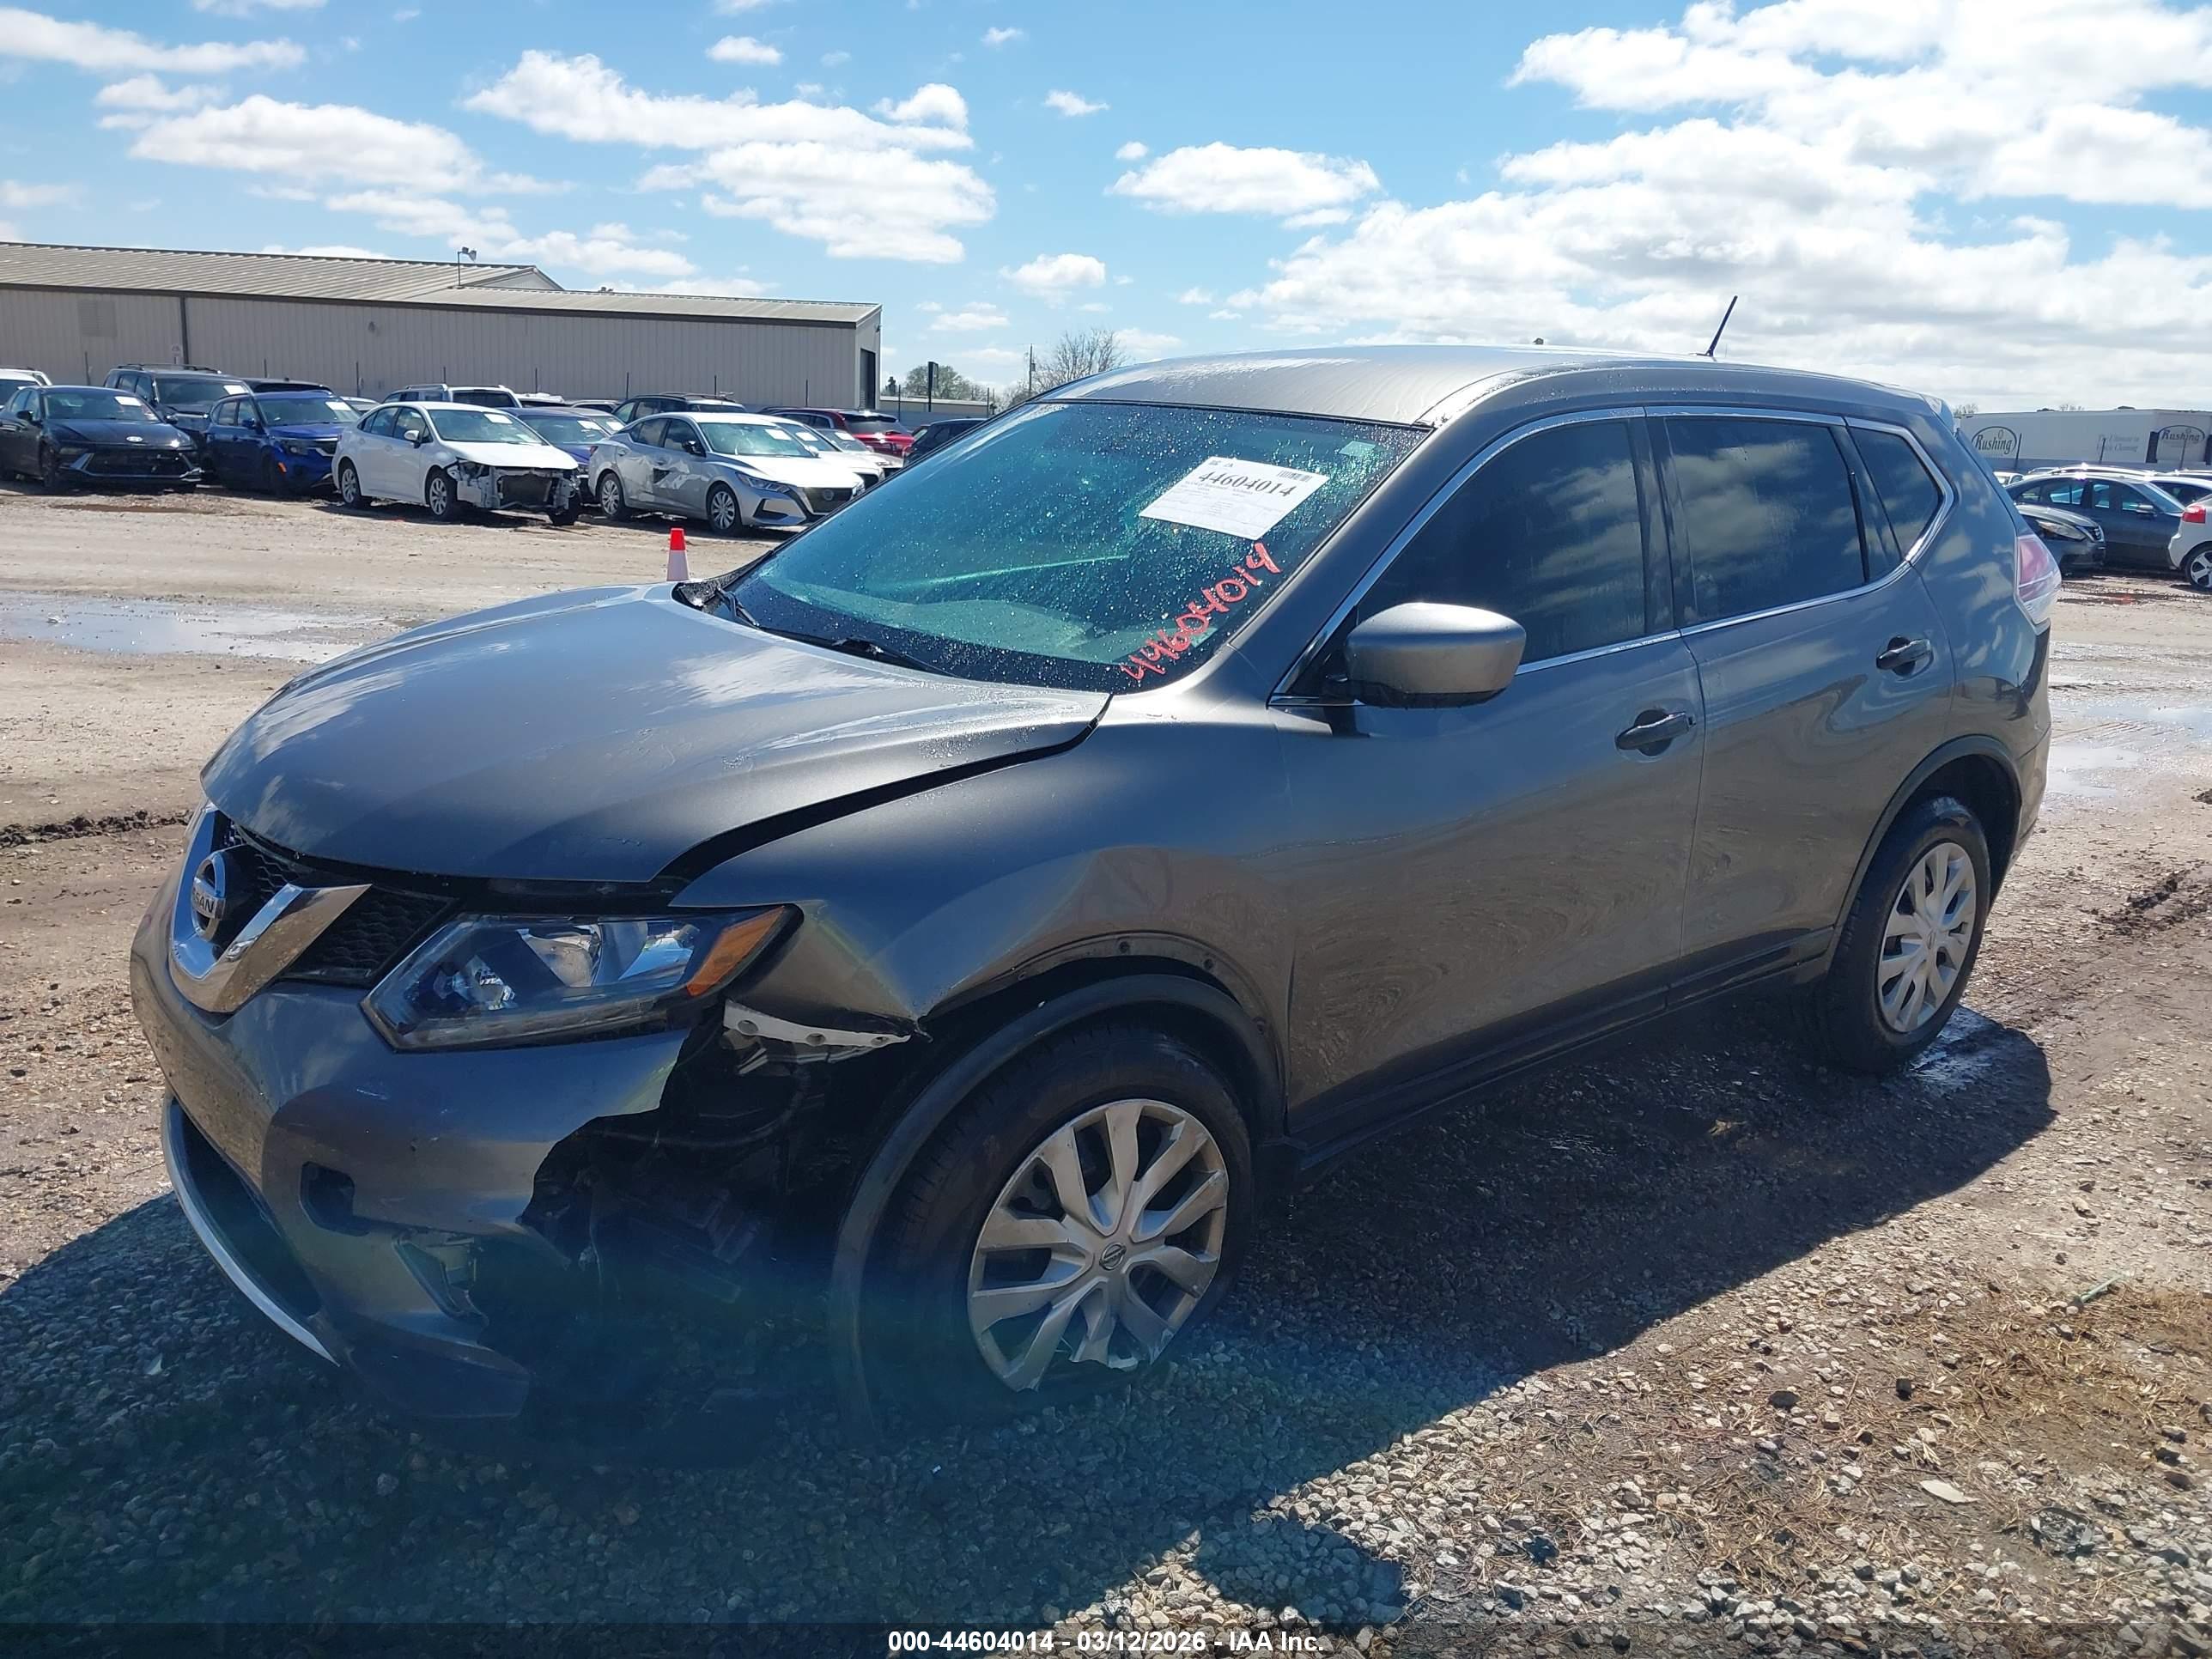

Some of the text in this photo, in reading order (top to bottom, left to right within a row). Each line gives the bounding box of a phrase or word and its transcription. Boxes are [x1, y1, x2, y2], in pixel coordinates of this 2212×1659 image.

[1975, 434, 2013, 455] Rushing
[2161, 429, 2200, 444] Rushing
[1199, 471, 1297, 497] 44604014
[1120, 542, 1282, 681] 44604014
